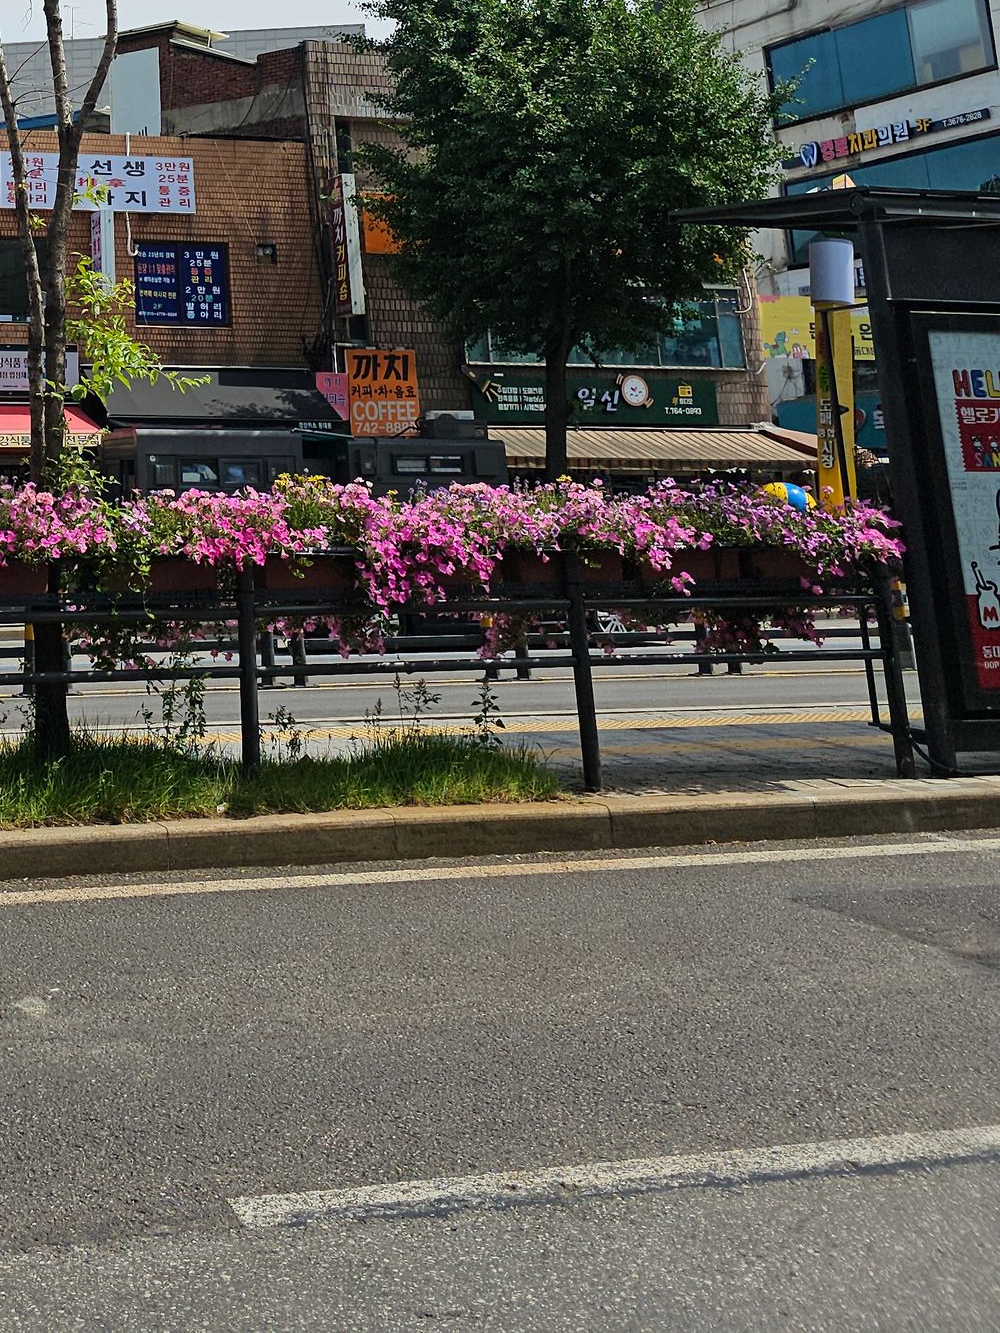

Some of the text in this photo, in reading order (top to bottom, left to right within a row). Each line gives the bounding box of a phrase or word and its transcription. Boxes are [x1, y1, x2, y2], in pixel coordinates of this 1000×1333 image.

[915, 118, 931, 133] 3F
[155, 162, 191, 173] 3만원
[158, 174, 189, 184] 25분
[158, 197, 191, 208] 관리
[352, 354, 409, 382] 까치
[952, 369, 1000, 398] HEL
[577, 387, 620, 412] 일신
[353, 400, 416, 421] COFFEE
